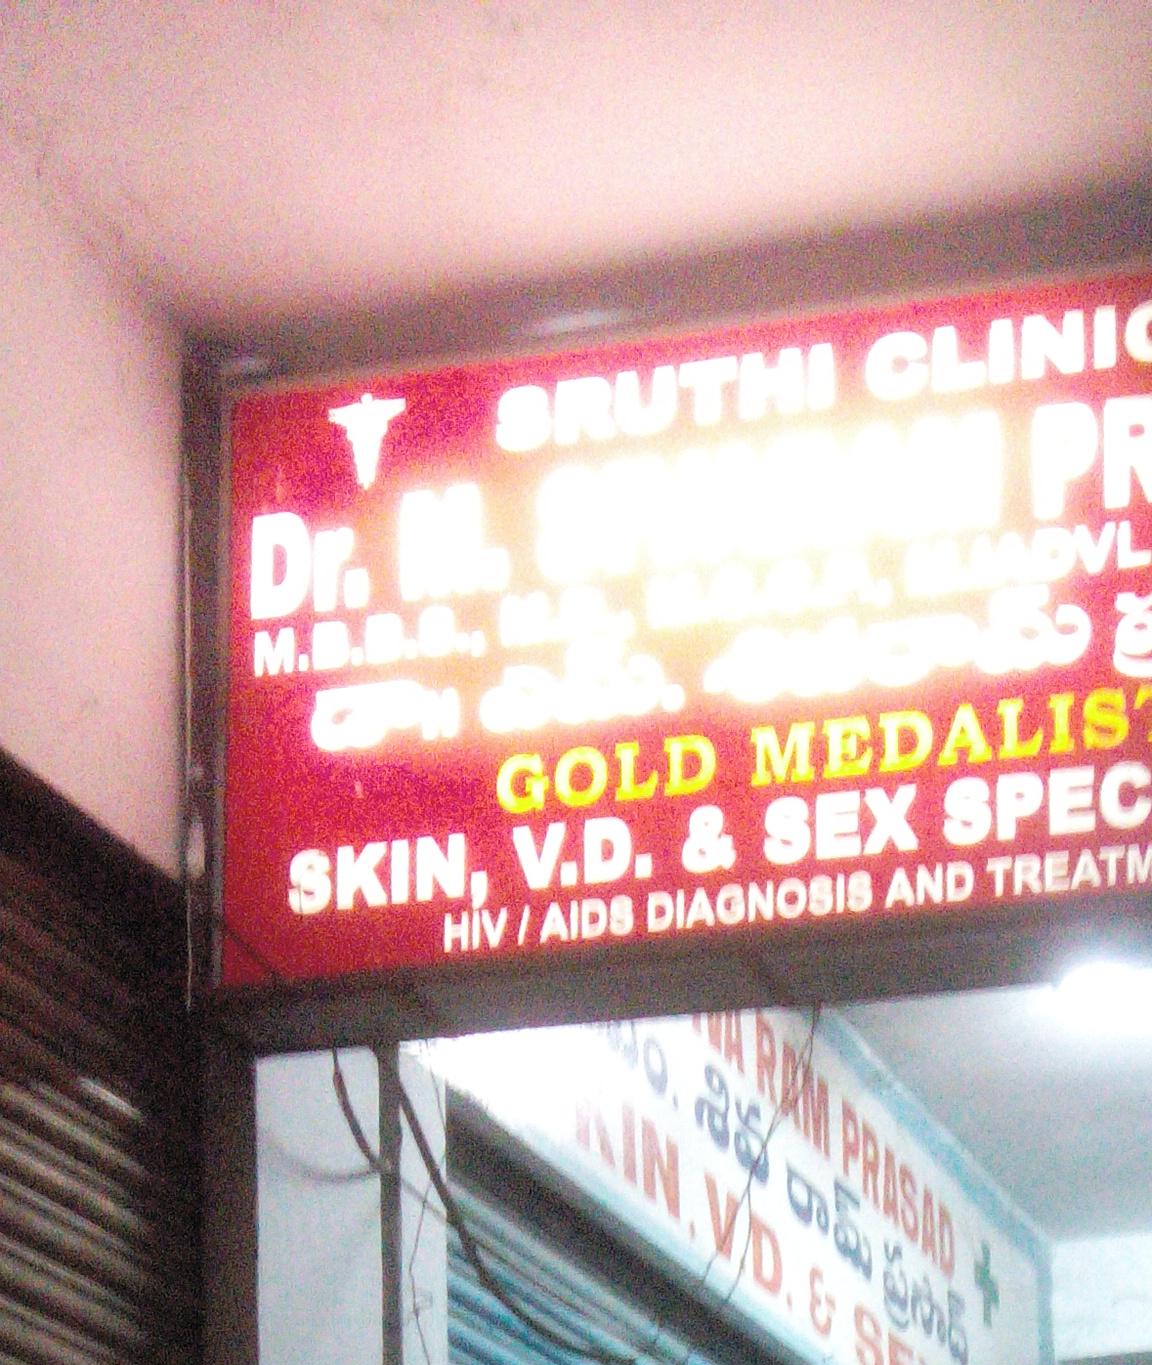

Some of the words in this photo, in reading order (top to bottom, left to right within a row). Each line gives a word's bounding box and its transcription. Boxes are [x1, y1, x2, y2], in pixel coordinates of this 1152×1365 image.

[496, 342, 835, 452] SRUTHI
[250, 511, 370, 620] Dr.
[497, 734, 717, 813] GOLD
[287, 832, 489, 915] SKIN,
[512, 816, 652, 889] V.D.
[683, 805, 736, 875] &
[764, 784, 919, 864] SEX
[444, 909, 508, 954] HIV
[540, 894, 633, 944] AIDS
[647, 871, 874, 934] DIAGNOSIS
[886, 861, 975, 910] AND
[841, 1097, 956, 1281] PRASAD
